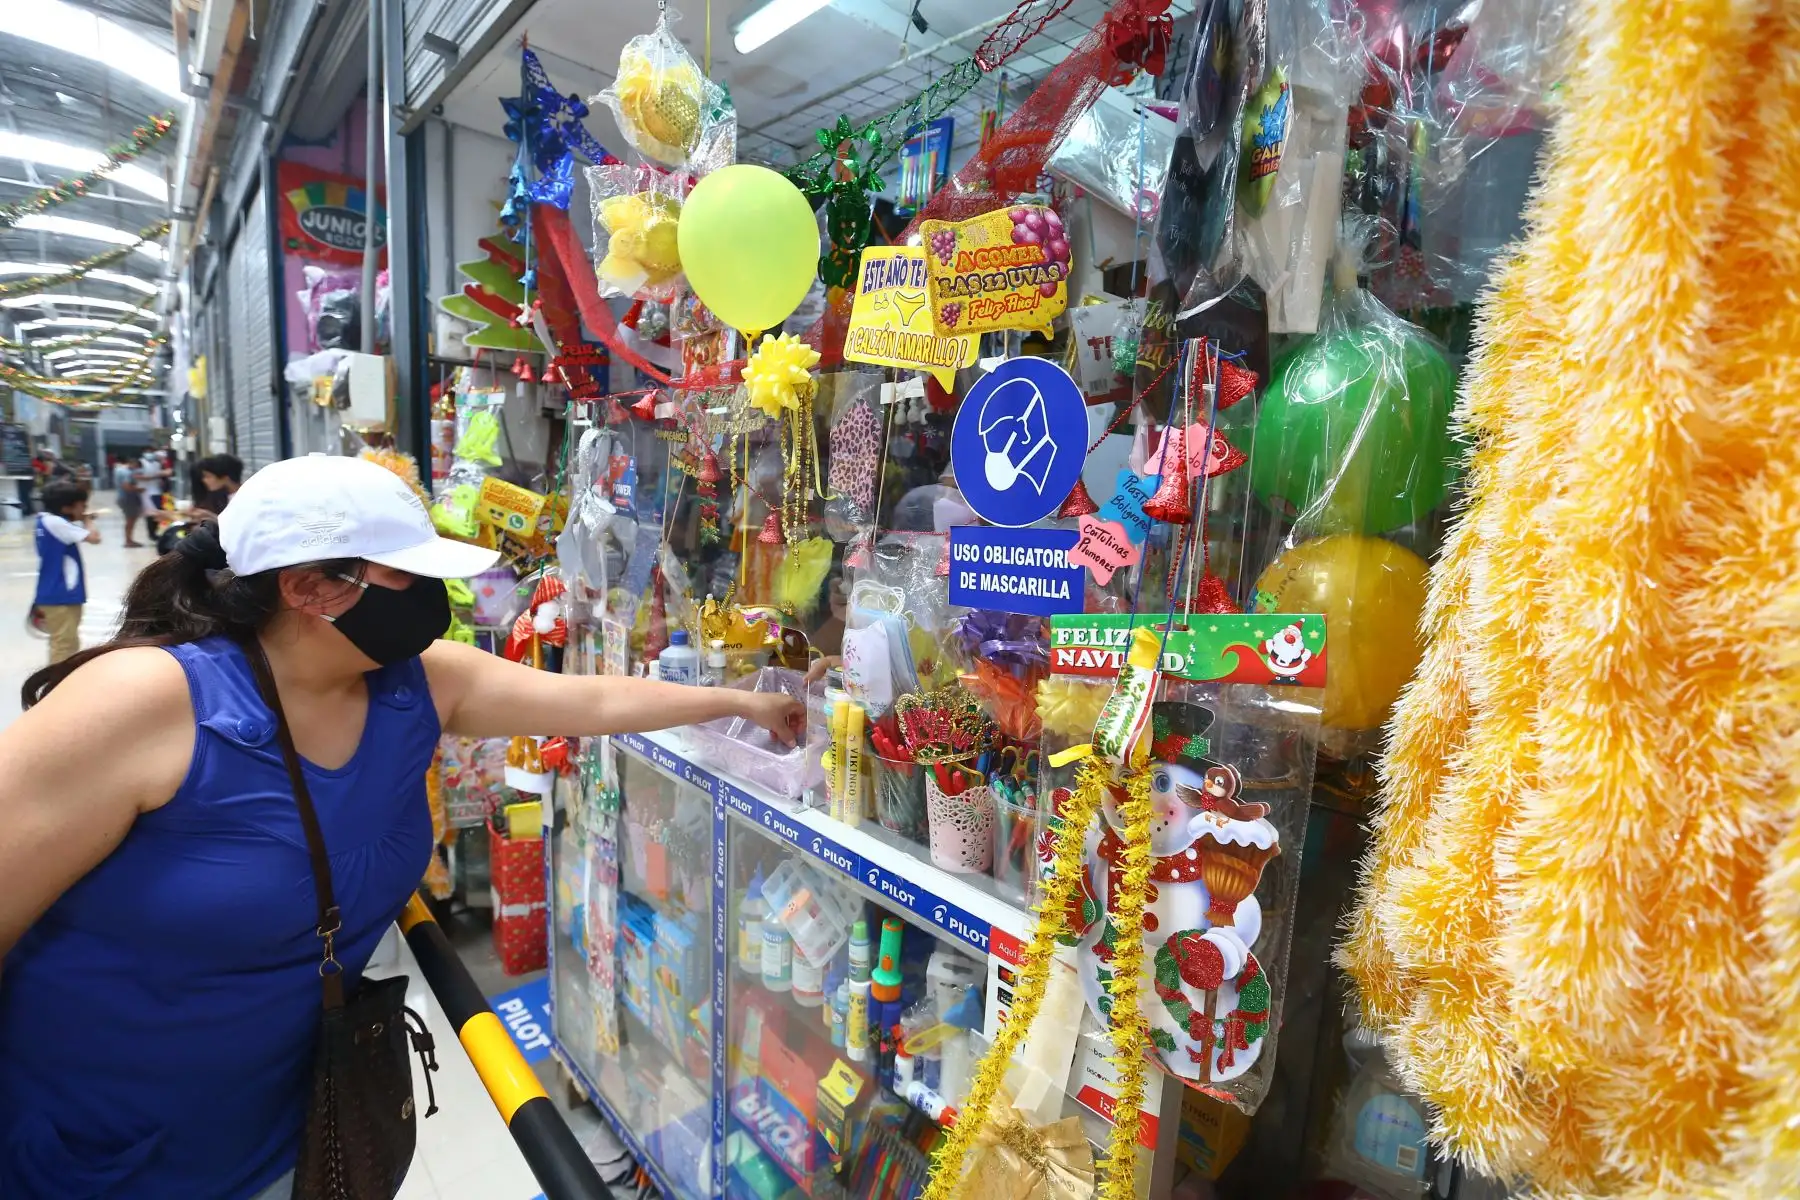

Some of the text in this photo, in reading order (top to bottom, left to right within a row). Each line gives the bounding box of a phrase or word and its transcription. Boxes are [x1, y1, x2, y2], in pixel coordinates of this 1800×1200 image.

[955, 244, 1044, 273] A COMER
[862, 259, 886, 294] ESTE
[885, 255, 908, 288] AÑO
[909, 258, 925, 288] TE
[938, 275, 982, 299] LAS
[980, 271, 1008, 293] 12
[1007, 263, 1061, 288] UVAS
[968, 298, 1005, 320] Feliz
[896, 331, 960, 369] AMARILLO
[300, 534, 350, 548] adidas
[953, 543, 980, 562] USO
[960, 571, 1071, 600] DE MASCARILLA
[1056, 628, 1132, 646] FELIZ
[1056, 649, 1187, 672] NAVID
[629, 737, 645, 753] PILOT
[658, 754, 676, 769] PILOT
[849, 747, 859, 797] VIKINGO
[692, 773, 712, 792] PILOT
[730, 795, 753, 815] PILOT
[773, 819, 799, 841] PILOT
[823, 847, 853, 872] PILOT
[881, 880, 916, 907] PILOT
[949, 922, 989, 948] PILOT
[497, 997, 552, 1051] PILOT
